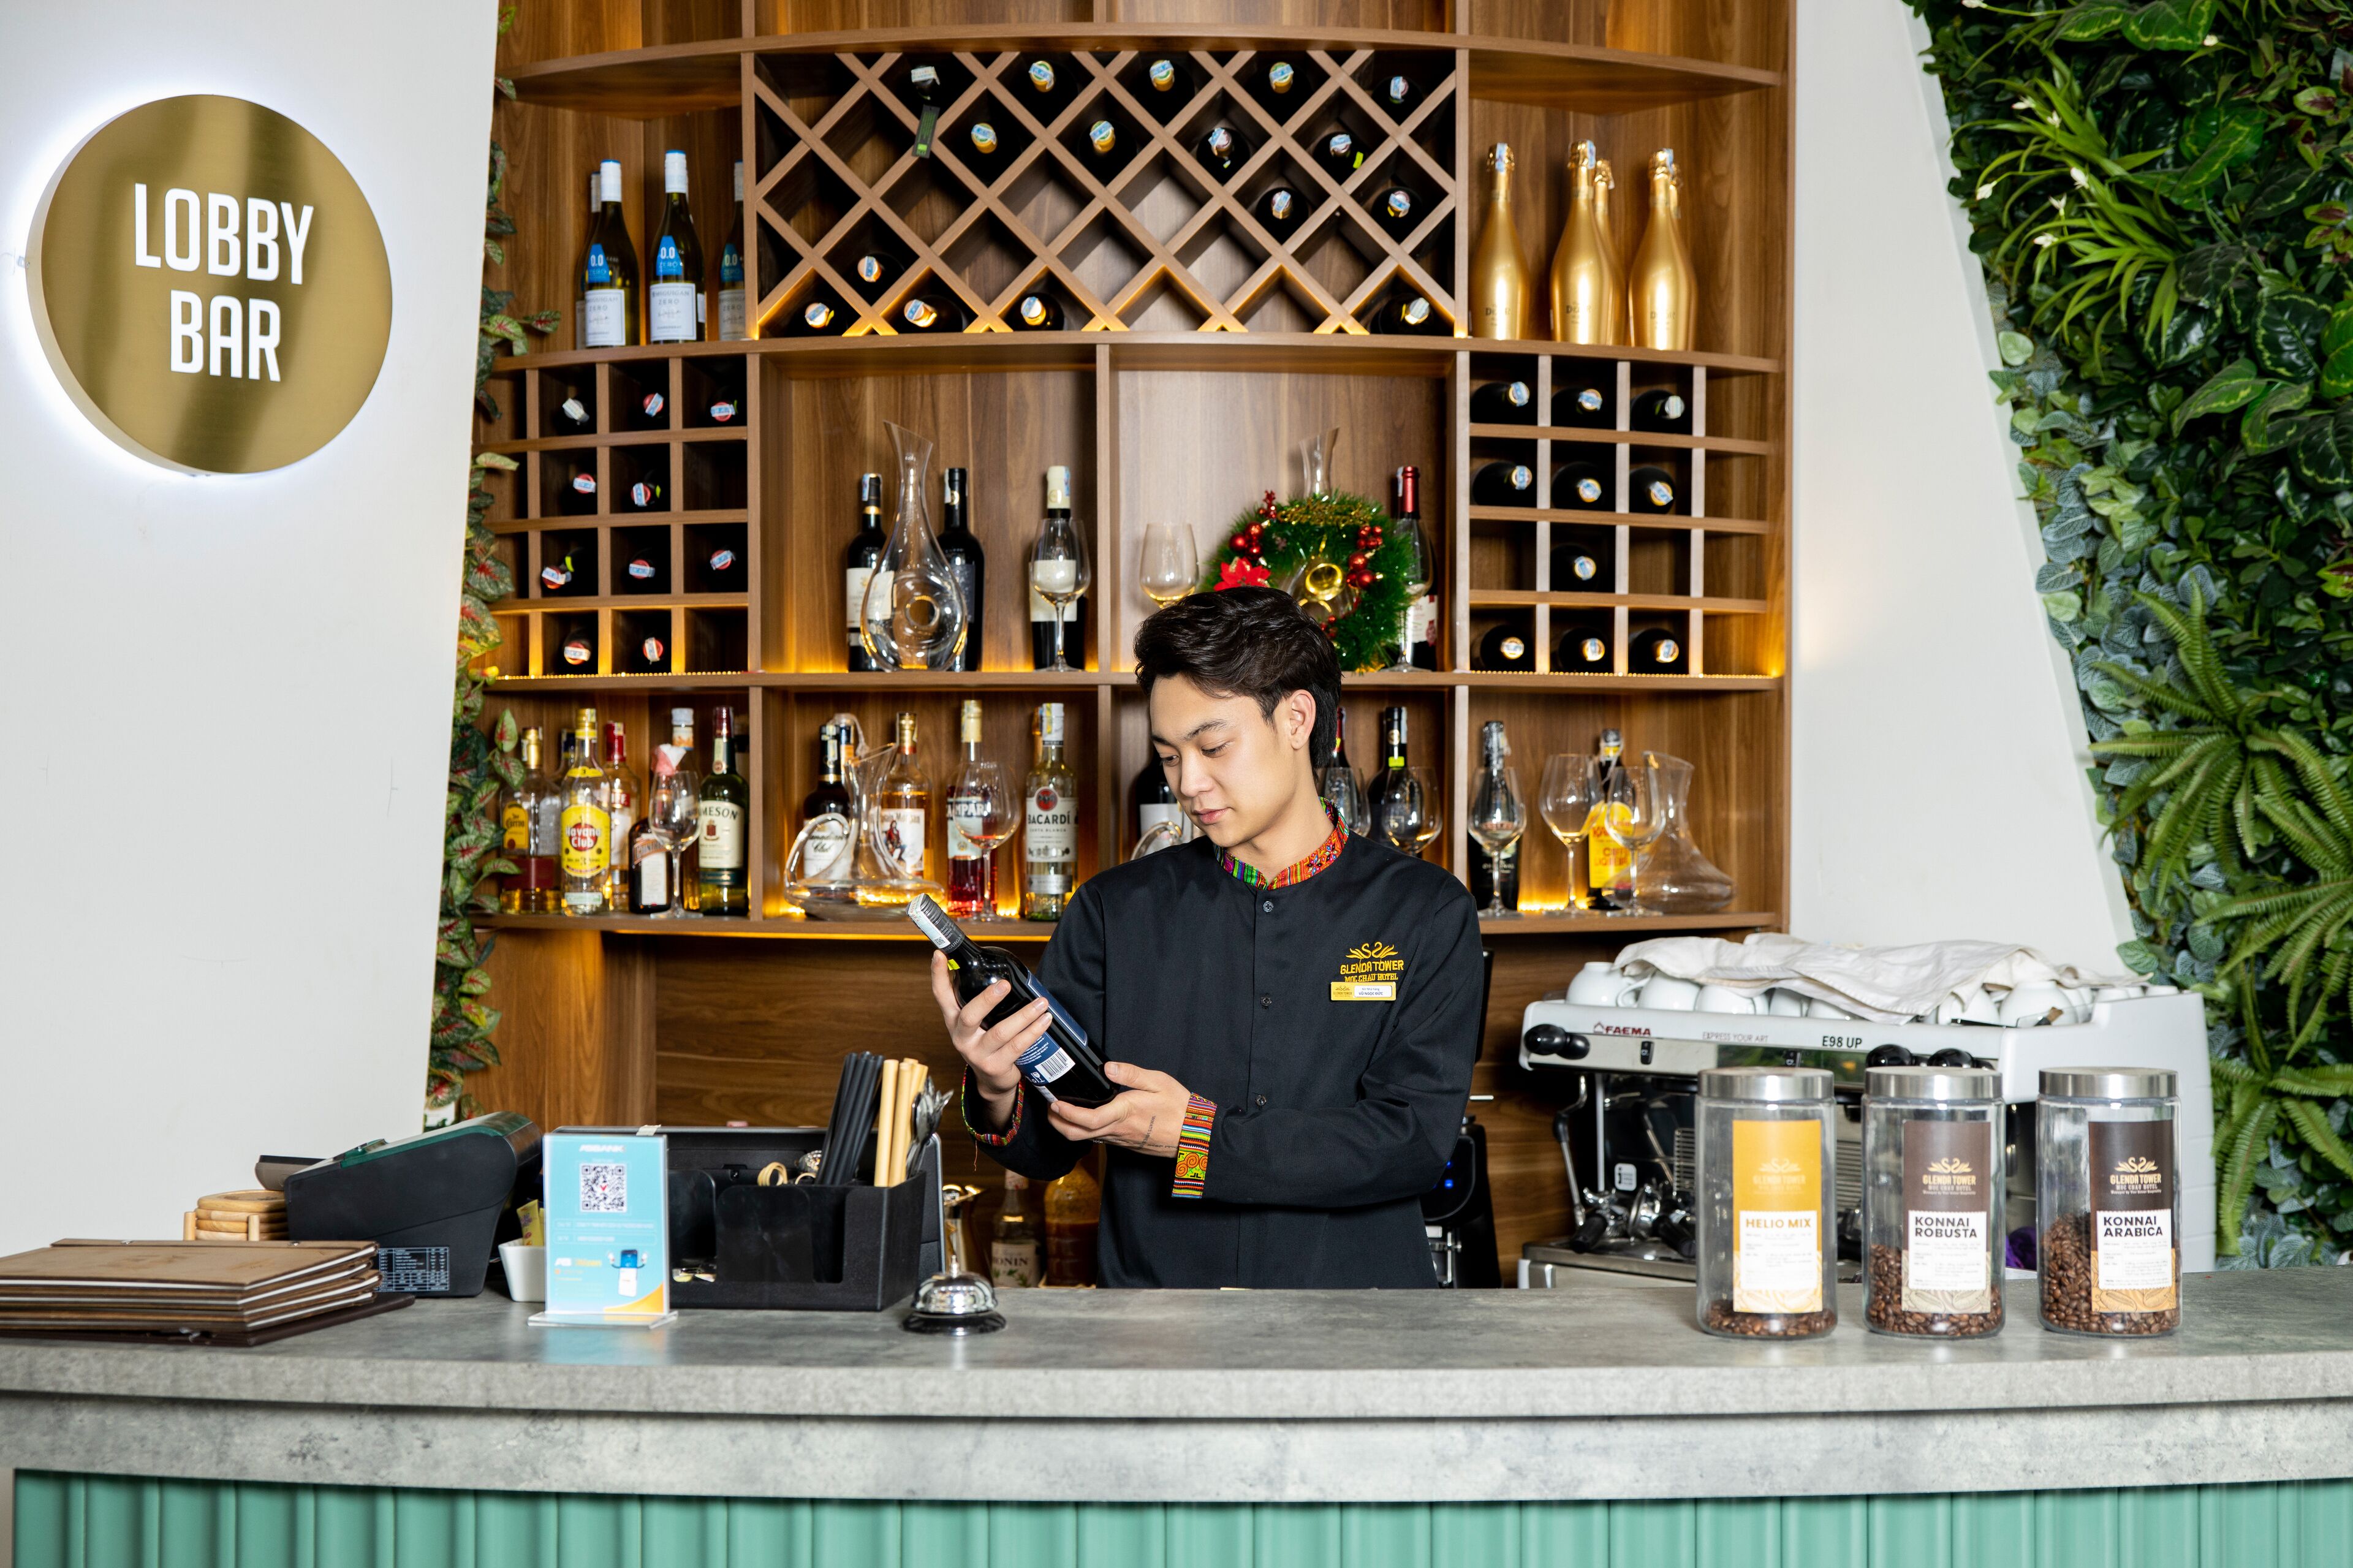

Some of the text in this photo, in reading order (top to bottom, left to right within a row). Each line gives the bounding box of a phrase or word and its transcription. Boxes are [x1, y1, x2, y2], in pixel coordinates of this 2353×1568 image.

[134, 183, 314, 285] LOBBY
[660, 246, 675, 259] 0.0
[590, 254, 604, 267] 0.0
[170, 290, 281, 382] BAR
[1028, 811, 1070, 825] BACARDÍ
[566, 825, 601, 837] Havana
[570, 837, 594, 848] Club
[1340, 960, 1404, 974] GLENDA TOWER
[1358, 973, 1376, 982] CHAU
[1605, 1026, 1651, 1036] FAEMA
[1702, 1031, 1730, 1041] EXPRESS
[1733, 1033, 1753, 1042] YOUR
[1822, 1036, 1863, 1049] E98 UP
[1922, 1175, 1976, 1186] GLENDA TOWER
[2110, 1173, 2162, 1185] GLENDA TOWER
[1746, 1218, 1811, 1229] HELIO MIX
[1915, 1216, 1969, 1227] KONNAI
[2104, 1216, 2157, 1226] KONNAI
[1915, 1227, 1977, 1238] ROBUSTA
[2104, 1227, 2163, 1237] ARABICA
